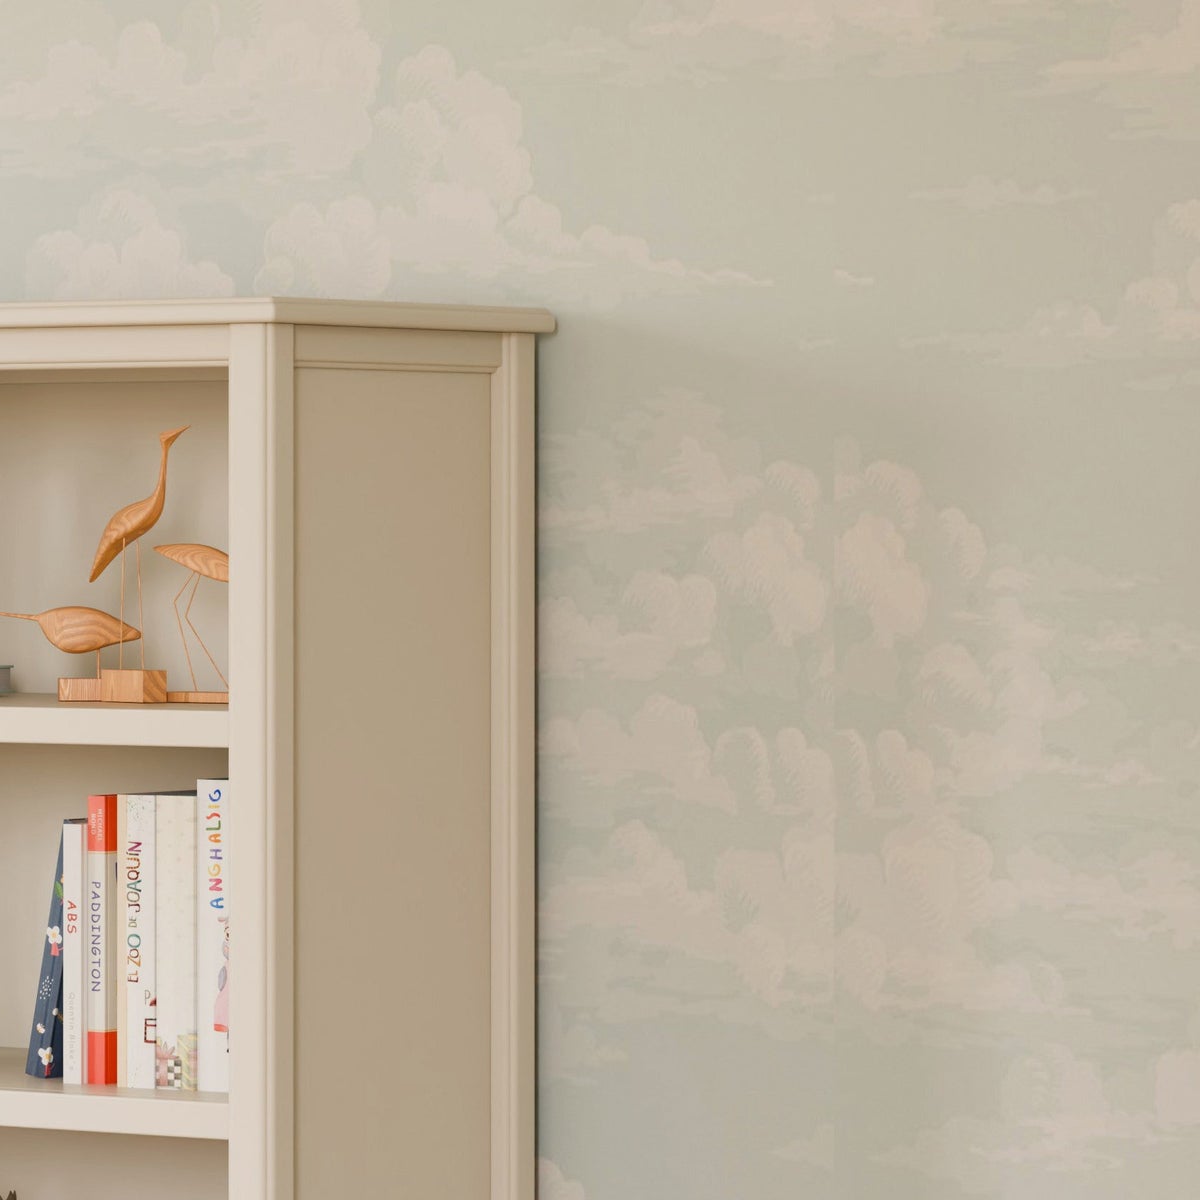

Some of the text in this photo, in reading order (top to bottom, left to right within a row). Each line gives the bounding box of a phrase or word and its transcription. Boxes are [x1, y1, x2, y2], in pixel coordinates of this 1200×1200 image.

[67, 900, 78, 934] ABS
[91, 881, 102, 992] PADDINGTON
[126, 841, 142, 983] EL ZOO DE JOAQUÍN
